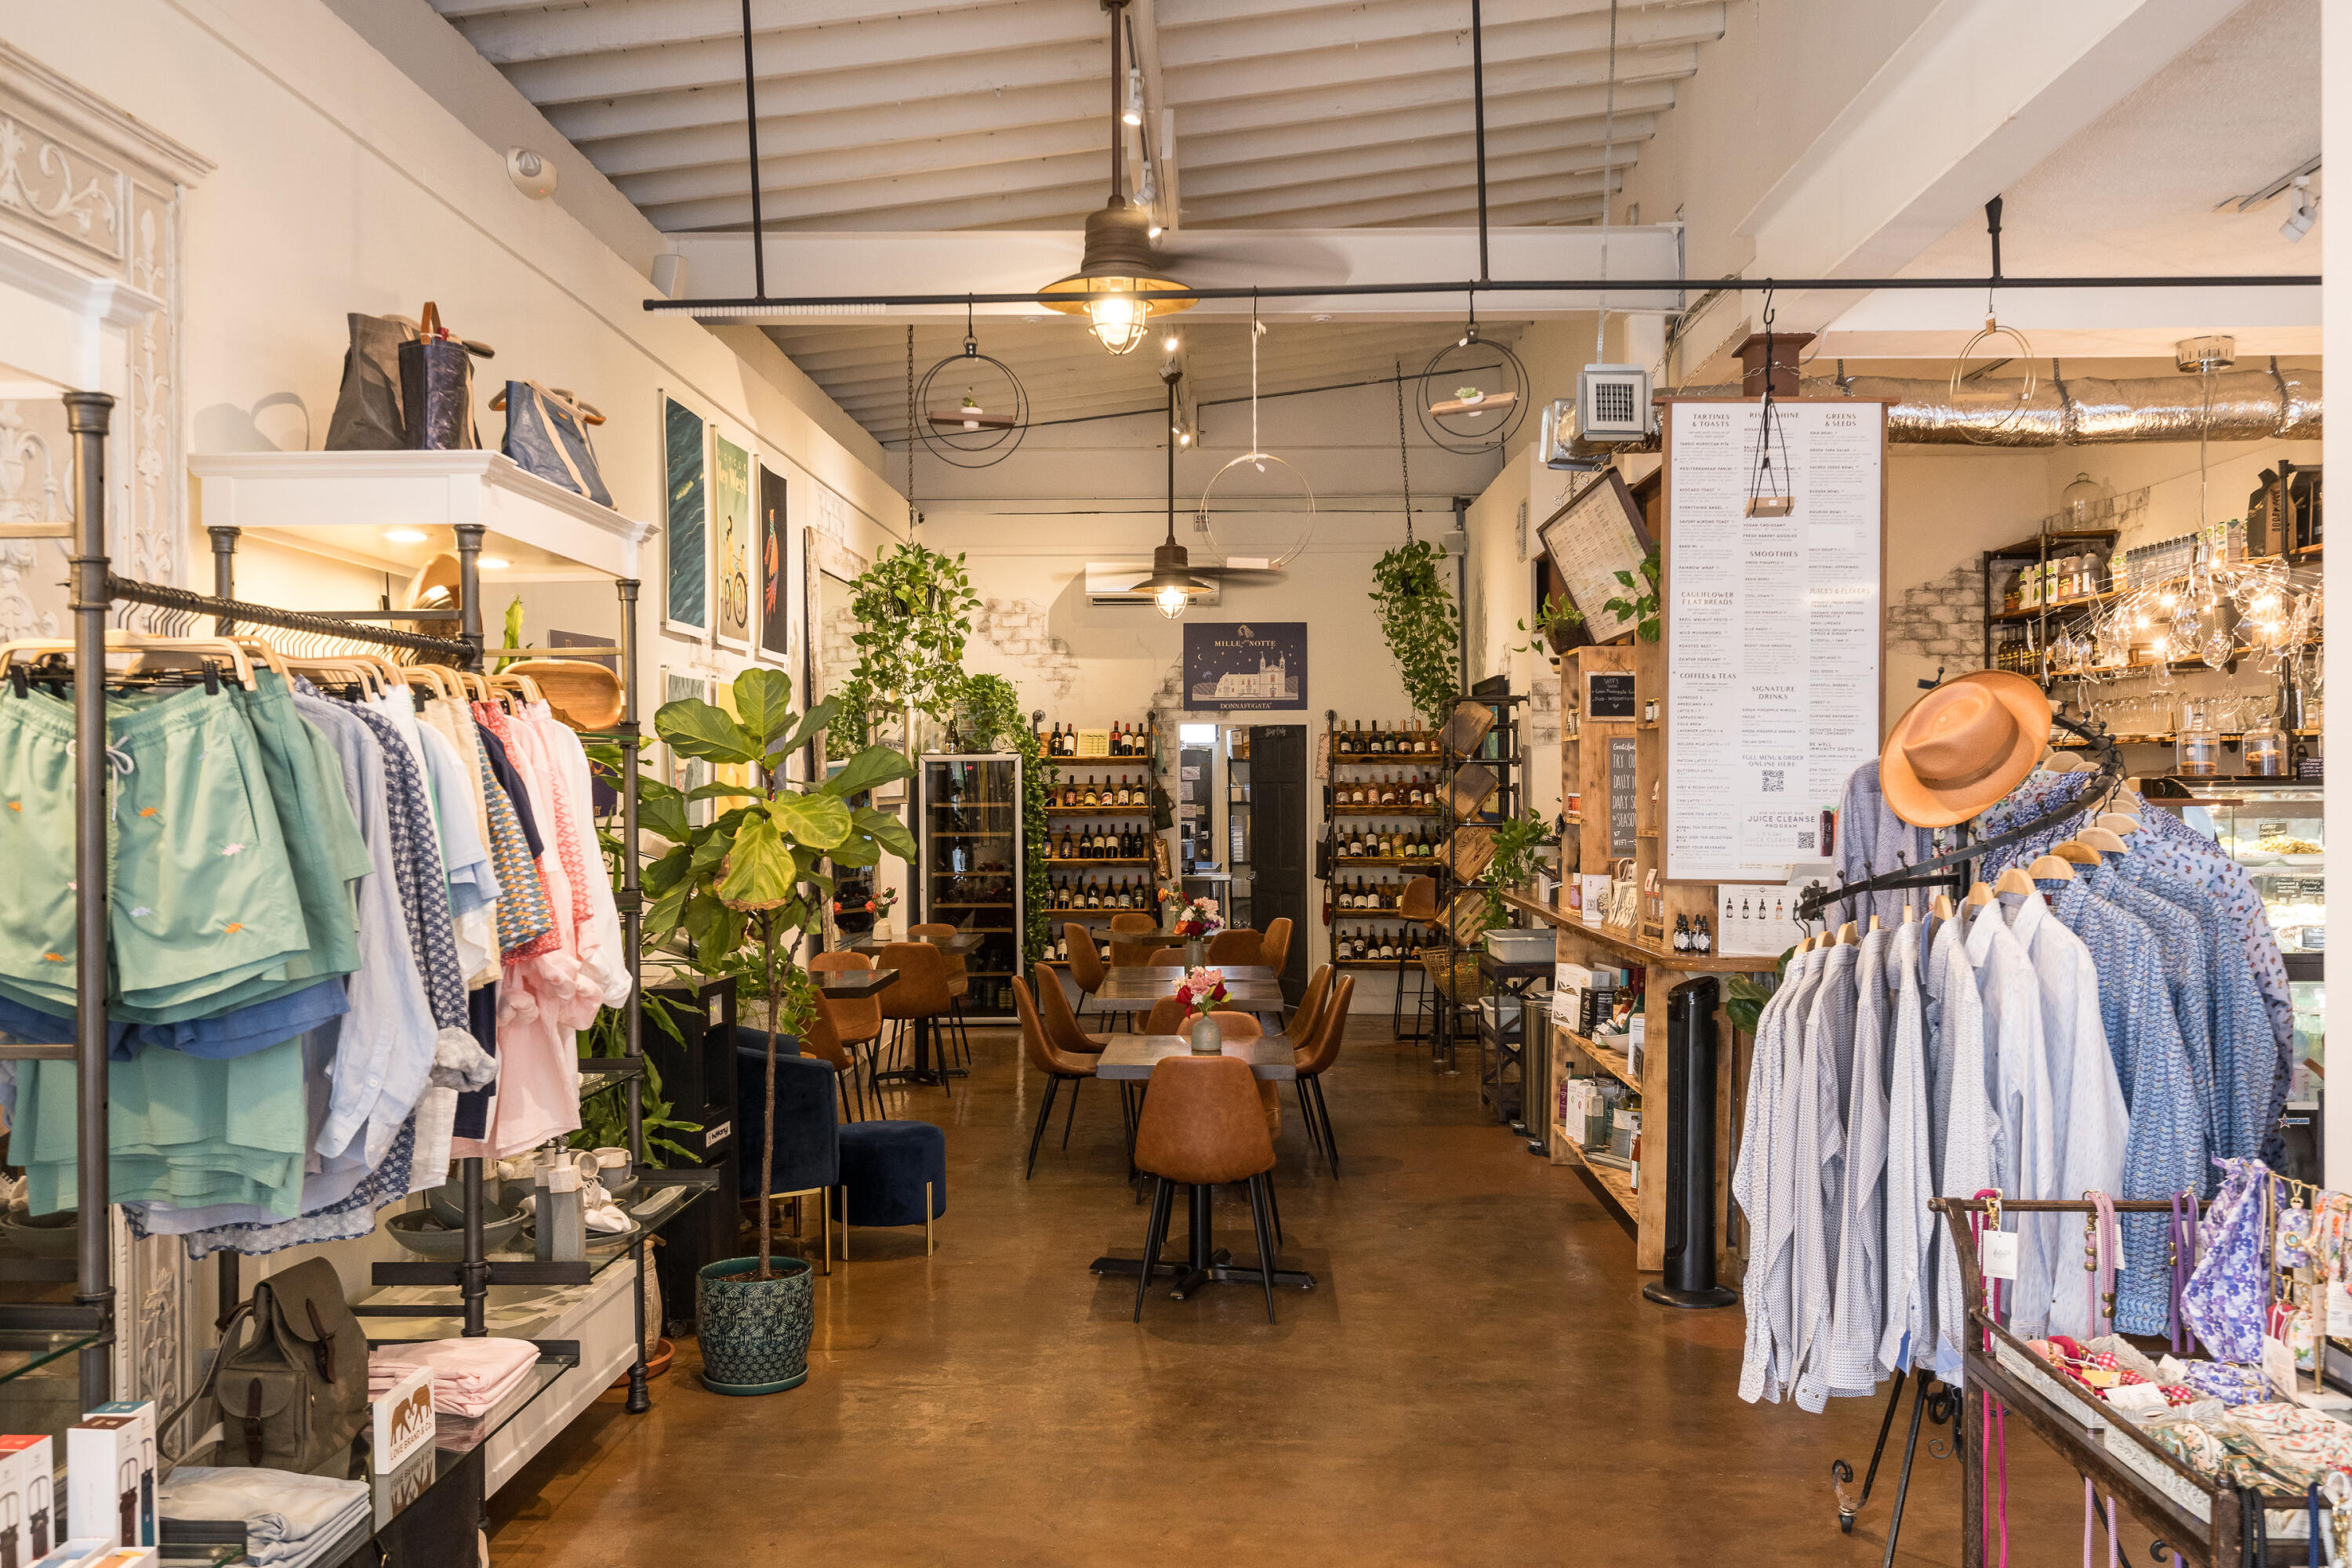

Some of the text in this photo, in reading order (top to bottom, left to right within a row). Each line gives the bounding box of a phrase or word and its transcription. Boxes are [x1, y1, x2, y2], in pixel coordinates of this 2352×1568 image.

[729, 467, 747, 495] West
[1613, 754, 1624, 769] TRY
[1613, 774, 1630, 790] DAILY
[1612, 794, 1628, 811] DAILY
[390, 1443, 404, 1462] LOVE
[404, 1431, 420, 1450] BRAND
